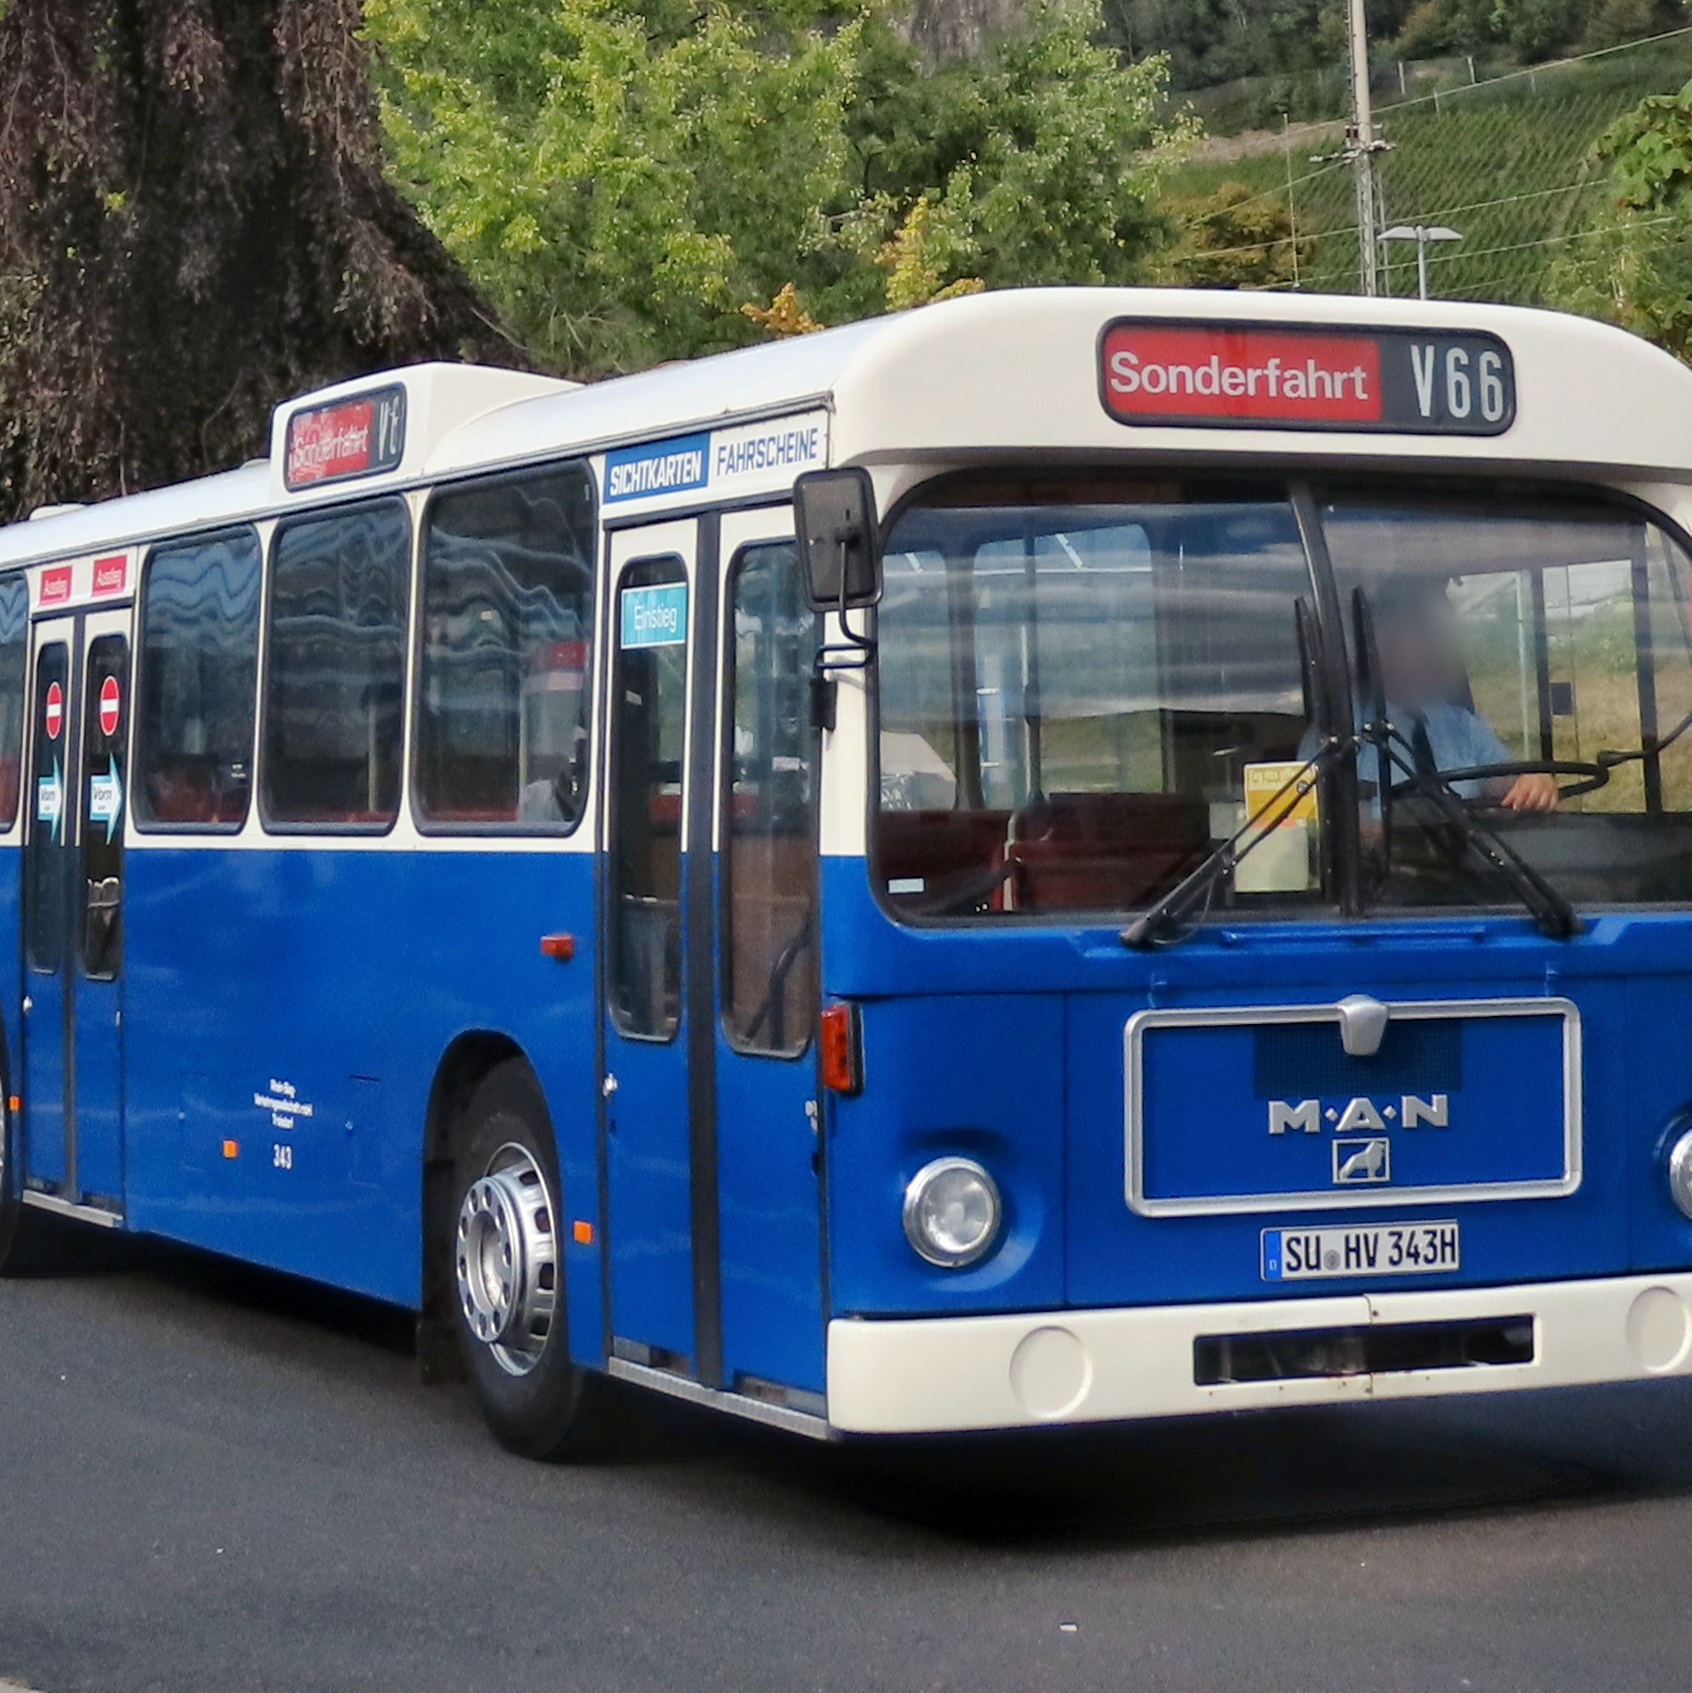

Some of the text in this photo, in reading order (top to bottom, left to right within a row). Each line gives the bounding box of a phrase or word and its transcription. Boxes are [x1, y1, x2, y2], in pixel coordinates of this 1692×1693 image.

[1110, 344, 1503, 423] Sonderfahrt V66
[609, 449, 703, 497] SICHTKARTEN
[716, 427, 819, 477] FAHRSCHEINE
[633, 605, 678, 634] Einstieg
[273, 1144, 292, 1170] 343
[1285, 1228, 1456, 1272] SU HV 343H
